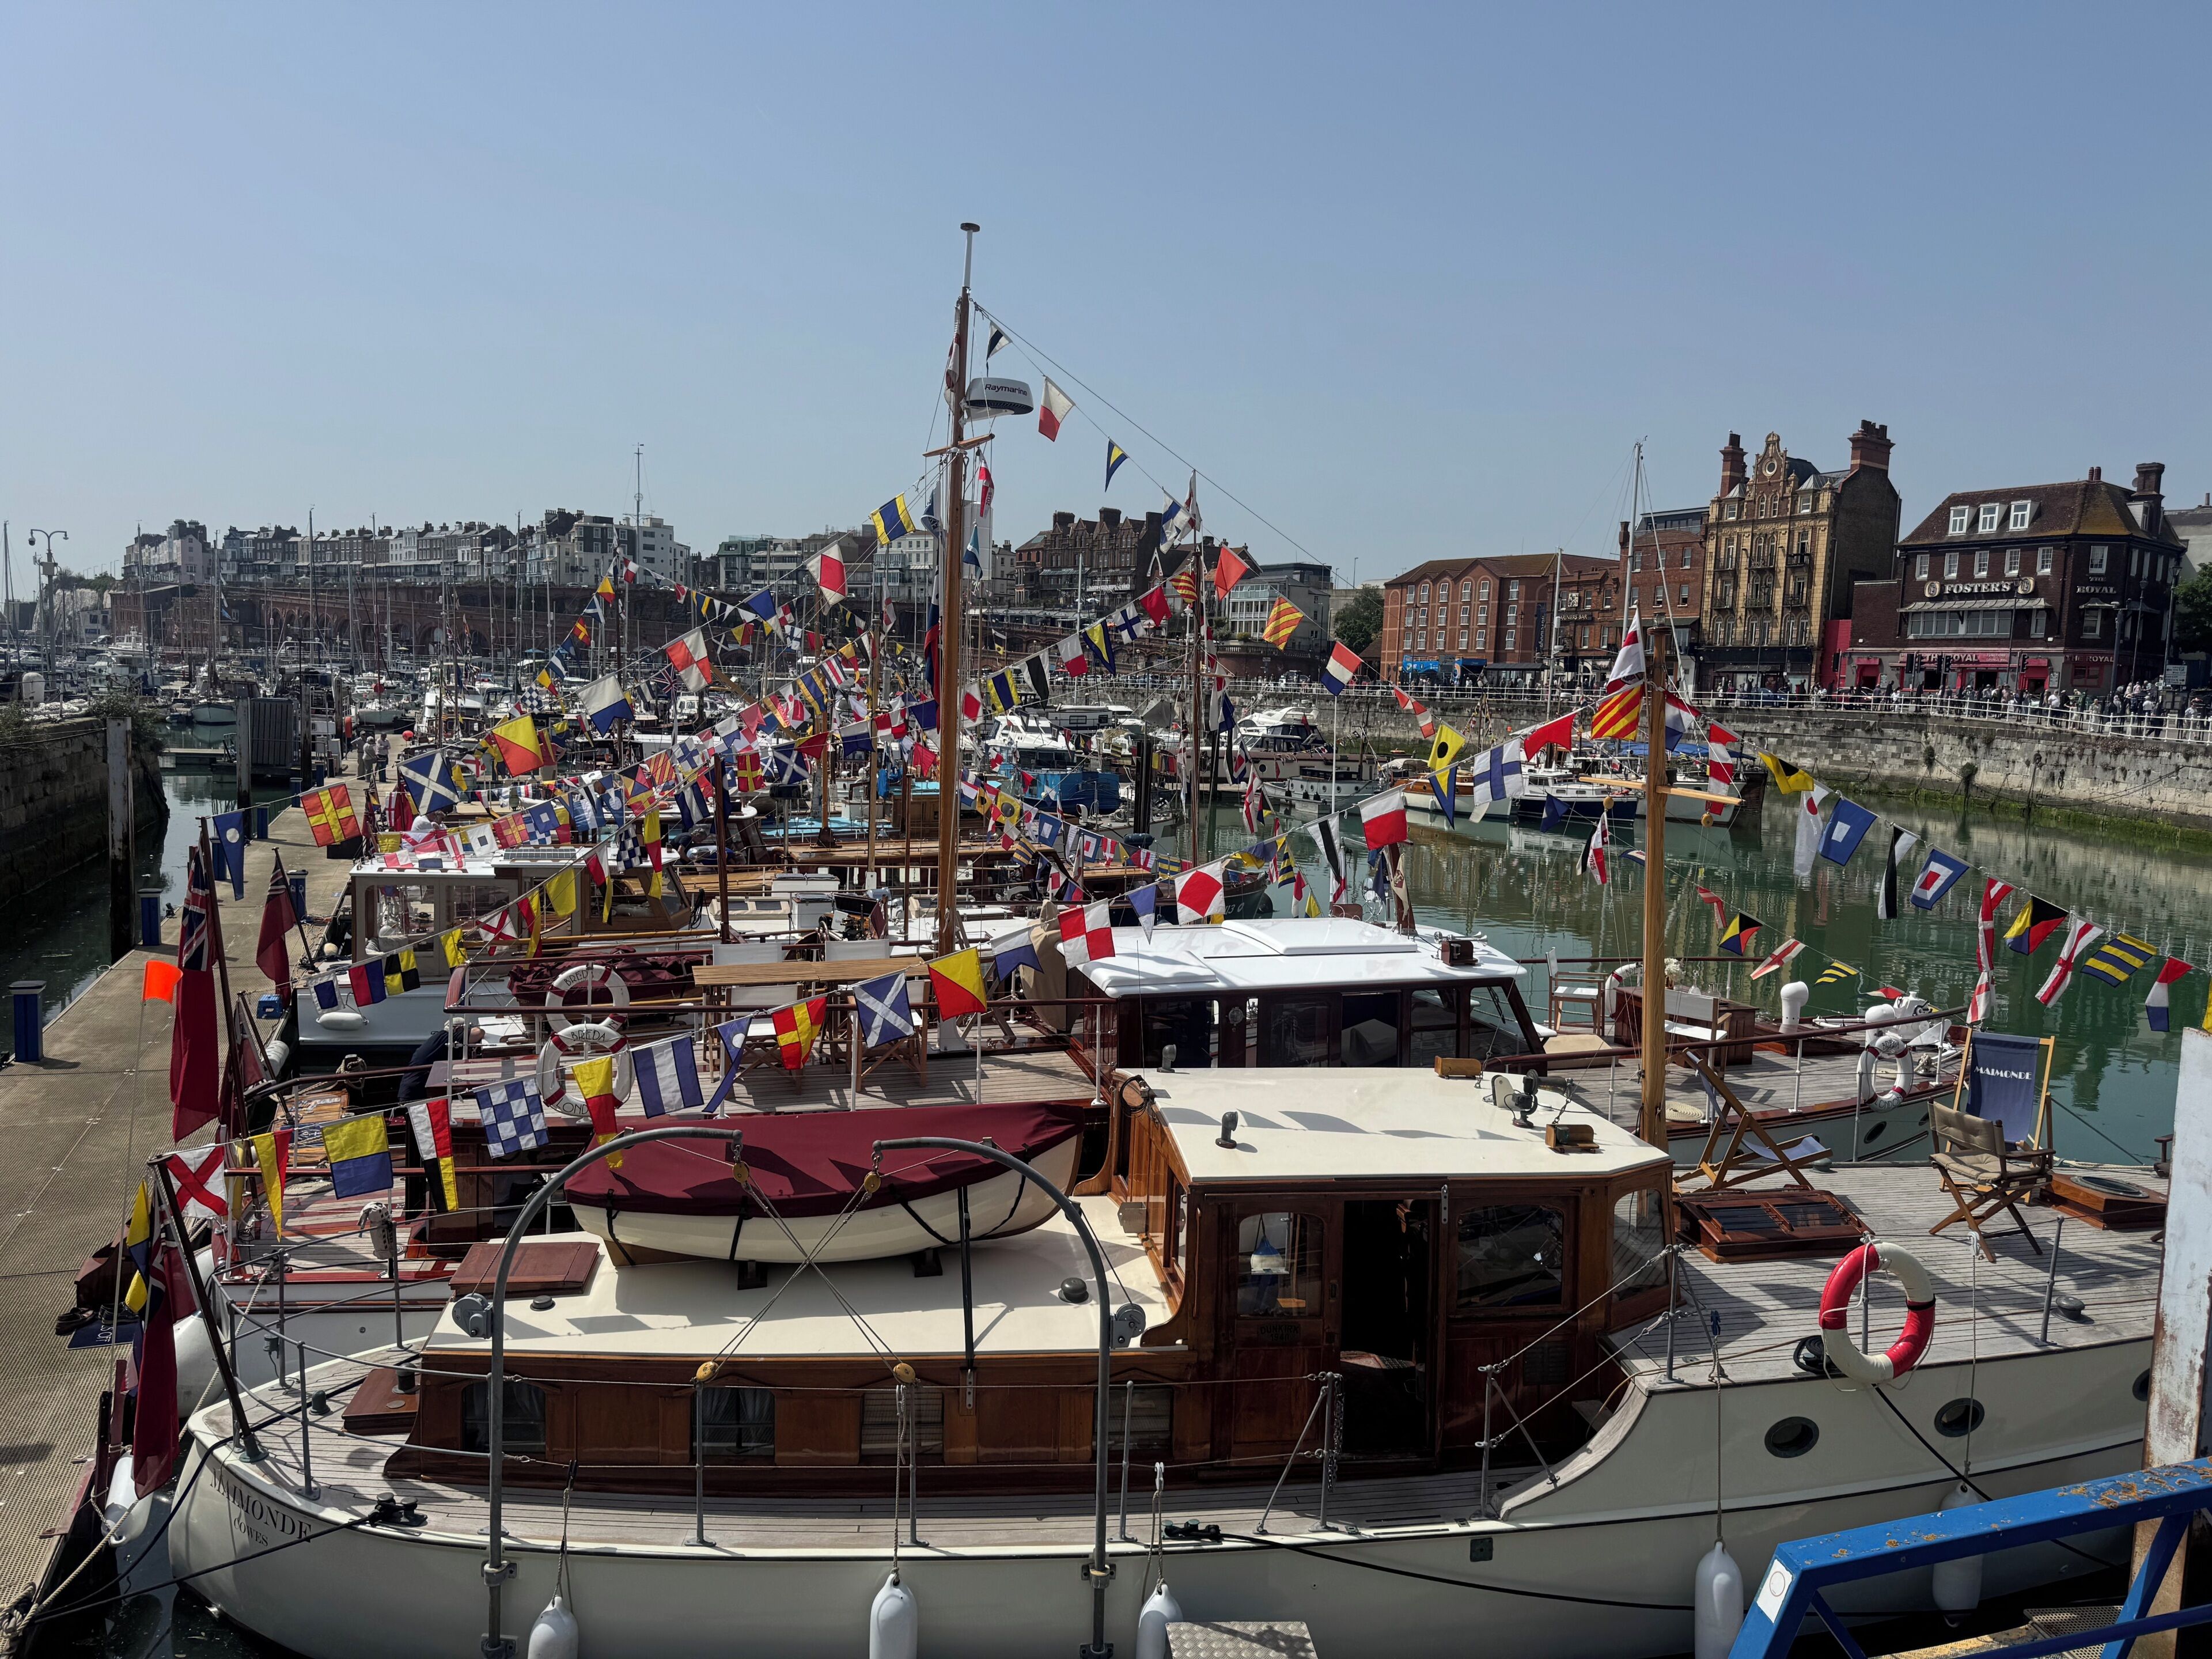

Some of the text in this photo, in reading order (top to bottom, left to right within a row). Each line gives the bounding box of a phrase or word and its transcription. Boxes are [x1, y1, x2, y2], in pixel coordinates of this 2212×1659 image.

[984, 384, 1028, 396] Raymarine
[1944, 581, 2013, 594] FOSTER'S
[2076, 586, 2116, 594] ROYAL
[1946, 654, 1979, 662] OYAL
[1589, 855, 1597, 870] 2025
[564, 969, 594, 986] BRED
[571, 1029, 605, 1041] BREDA
[1974, 1066, 2032, 1080] MAIMONDE
[556, 1098, 589, 1115] LOND
[1260, 1325, 1299, 1334] DUNKIRK
[96, 1332, 112, 1342] OFF
[210, 1468, 312, 1543] MAIMONDE
[233, 1517, 268, 1547] COWES
